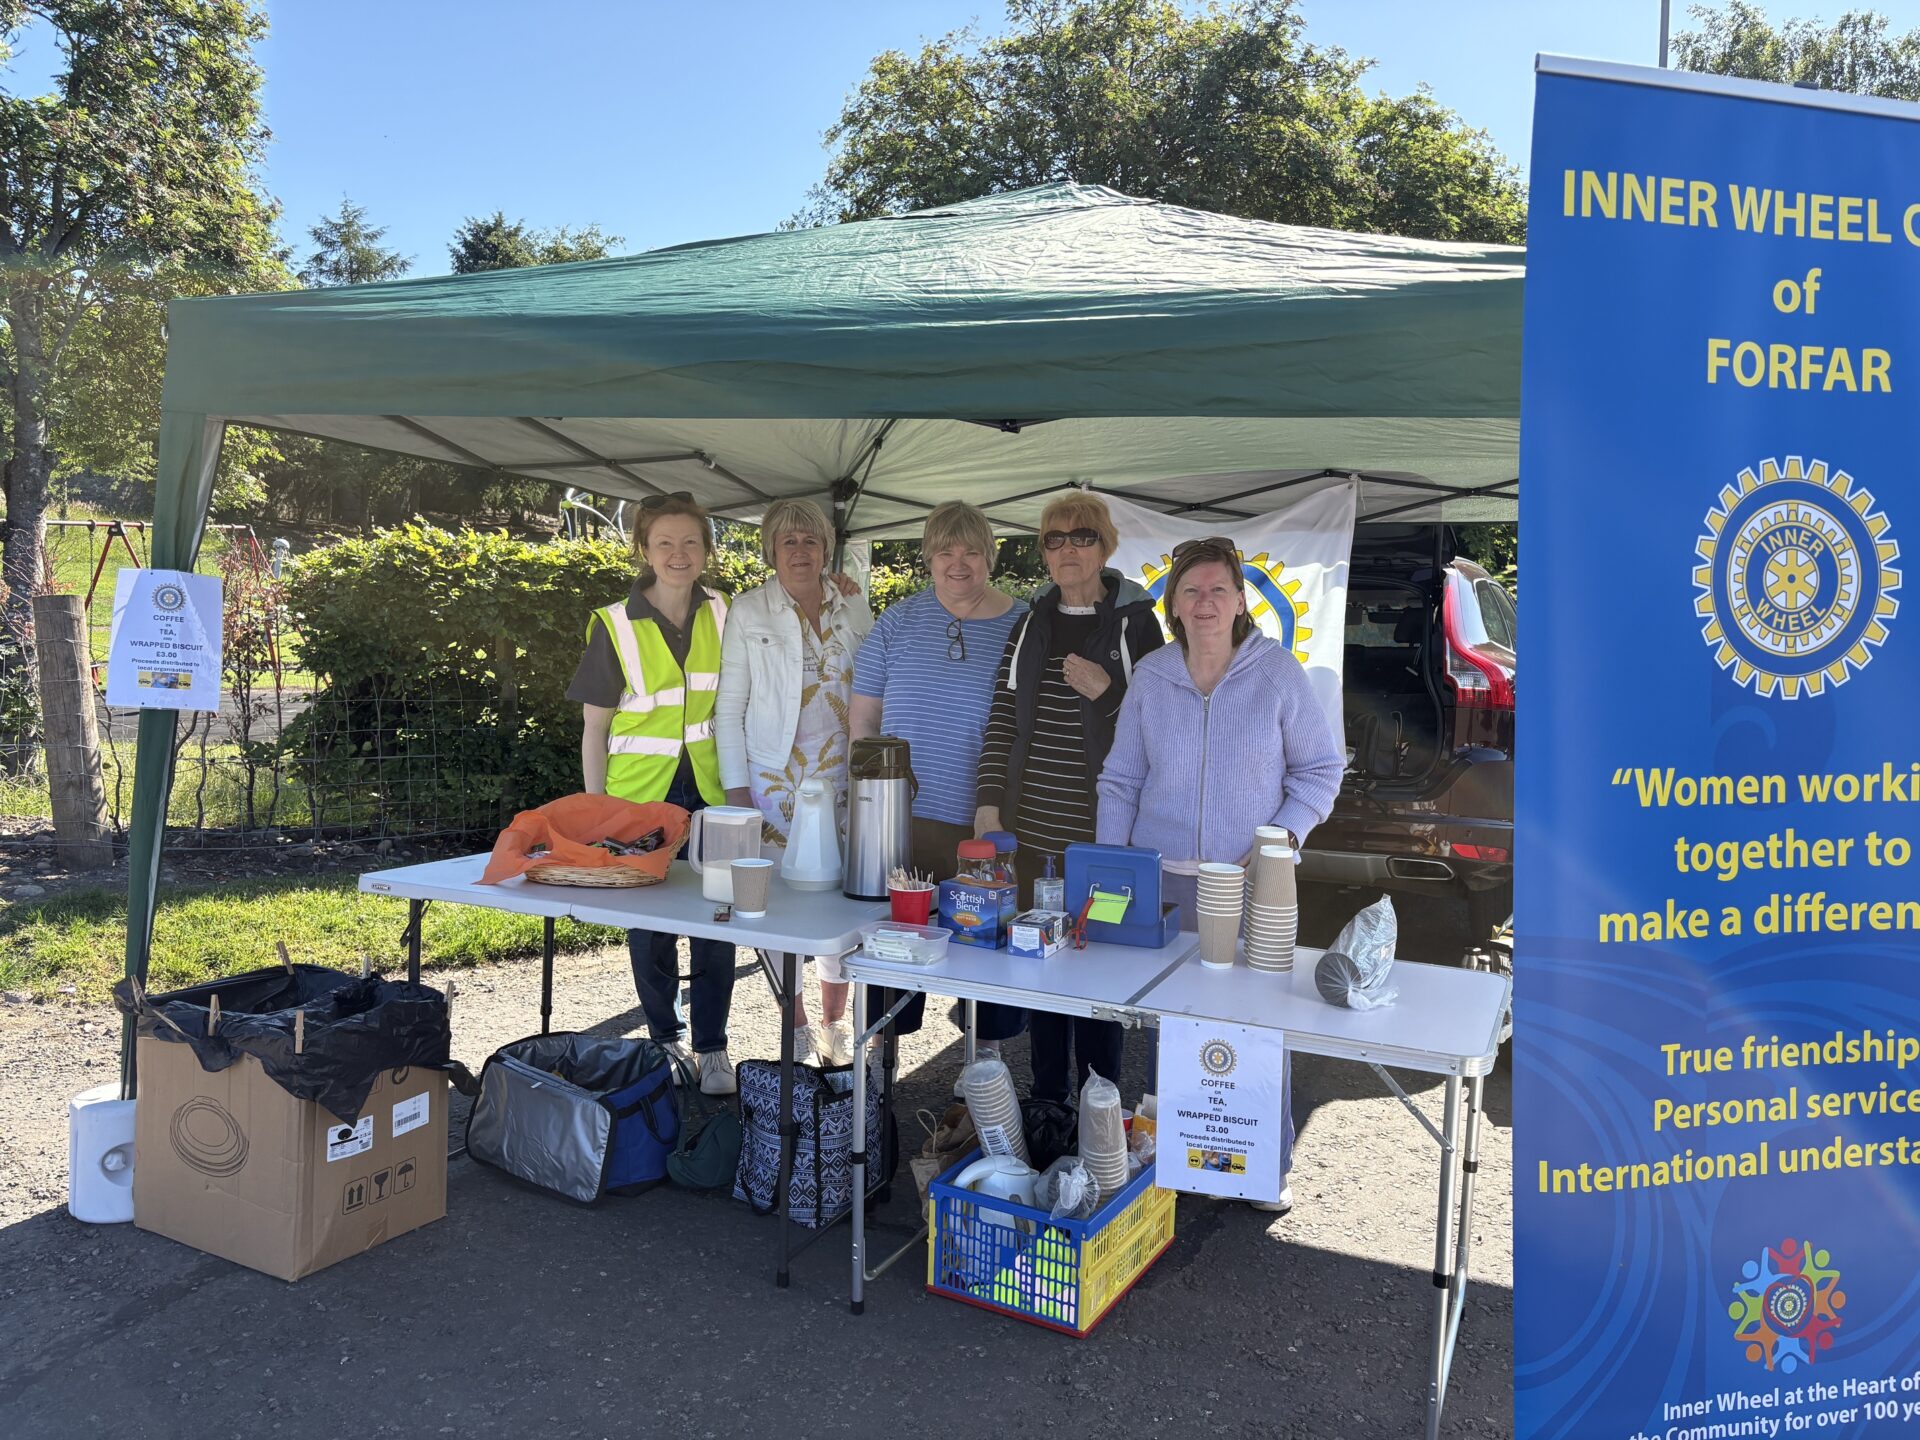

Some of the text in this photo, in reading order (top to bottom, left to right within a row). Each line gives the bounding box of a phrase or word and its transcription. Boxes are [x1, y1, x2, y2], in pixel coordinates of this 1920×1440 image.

[1563, 169, 1718, 228] INNER
[1728, 183, 1892, 243] WHEEL
[1773, 268, 1822, 314] of
[1707, 338, 1892, 393] FORFAR
[1760, 528, 1825, 558] INNER
[153, 614, 184, 623] COFFEE
[1756, 597, 1826, 632] WHEEL
[130, 640, 203, 651] WRAPPED BISCUIT
[160, 659, 193, 667] distributed
[1798, 762, 1920, 803] worki
[1674, 828, 1911, 882] together to
[949, 890, 985, 905] Scottish
[956, 900, 980, 912] Blend
[1599, 892, 1920, 943] make a differen
[1660, 1029, 1920, 1076] True friendship
[1201, 1078, 1236, 1090] COFFEE
[1208, 1096, 1227, 1106] TEA,
[1654, 1081, 1920, 1131] Personal service
[1177, 1110, 1258, 1127] WRAPPED BISCUIT
[1205, 1125, 1229, 1134] £3.00
[1179, 1131, 1210, 1142] Proceeds
[1211, 1135, 1247, 1146] distributed
[1186, 1141, 1248, 1154] local organisations
[1538, 1142, 1768, 1193] International
[1663, 1370, 1920, 1421] Inner Wheel at the Heart of
[1666, 1415, 1780, 1440] Community
[1784, 1411, 1813, 1432] for
[1816, 1407, 1859, 1426] over
[1863, 1400, 1898, 1420] 100
